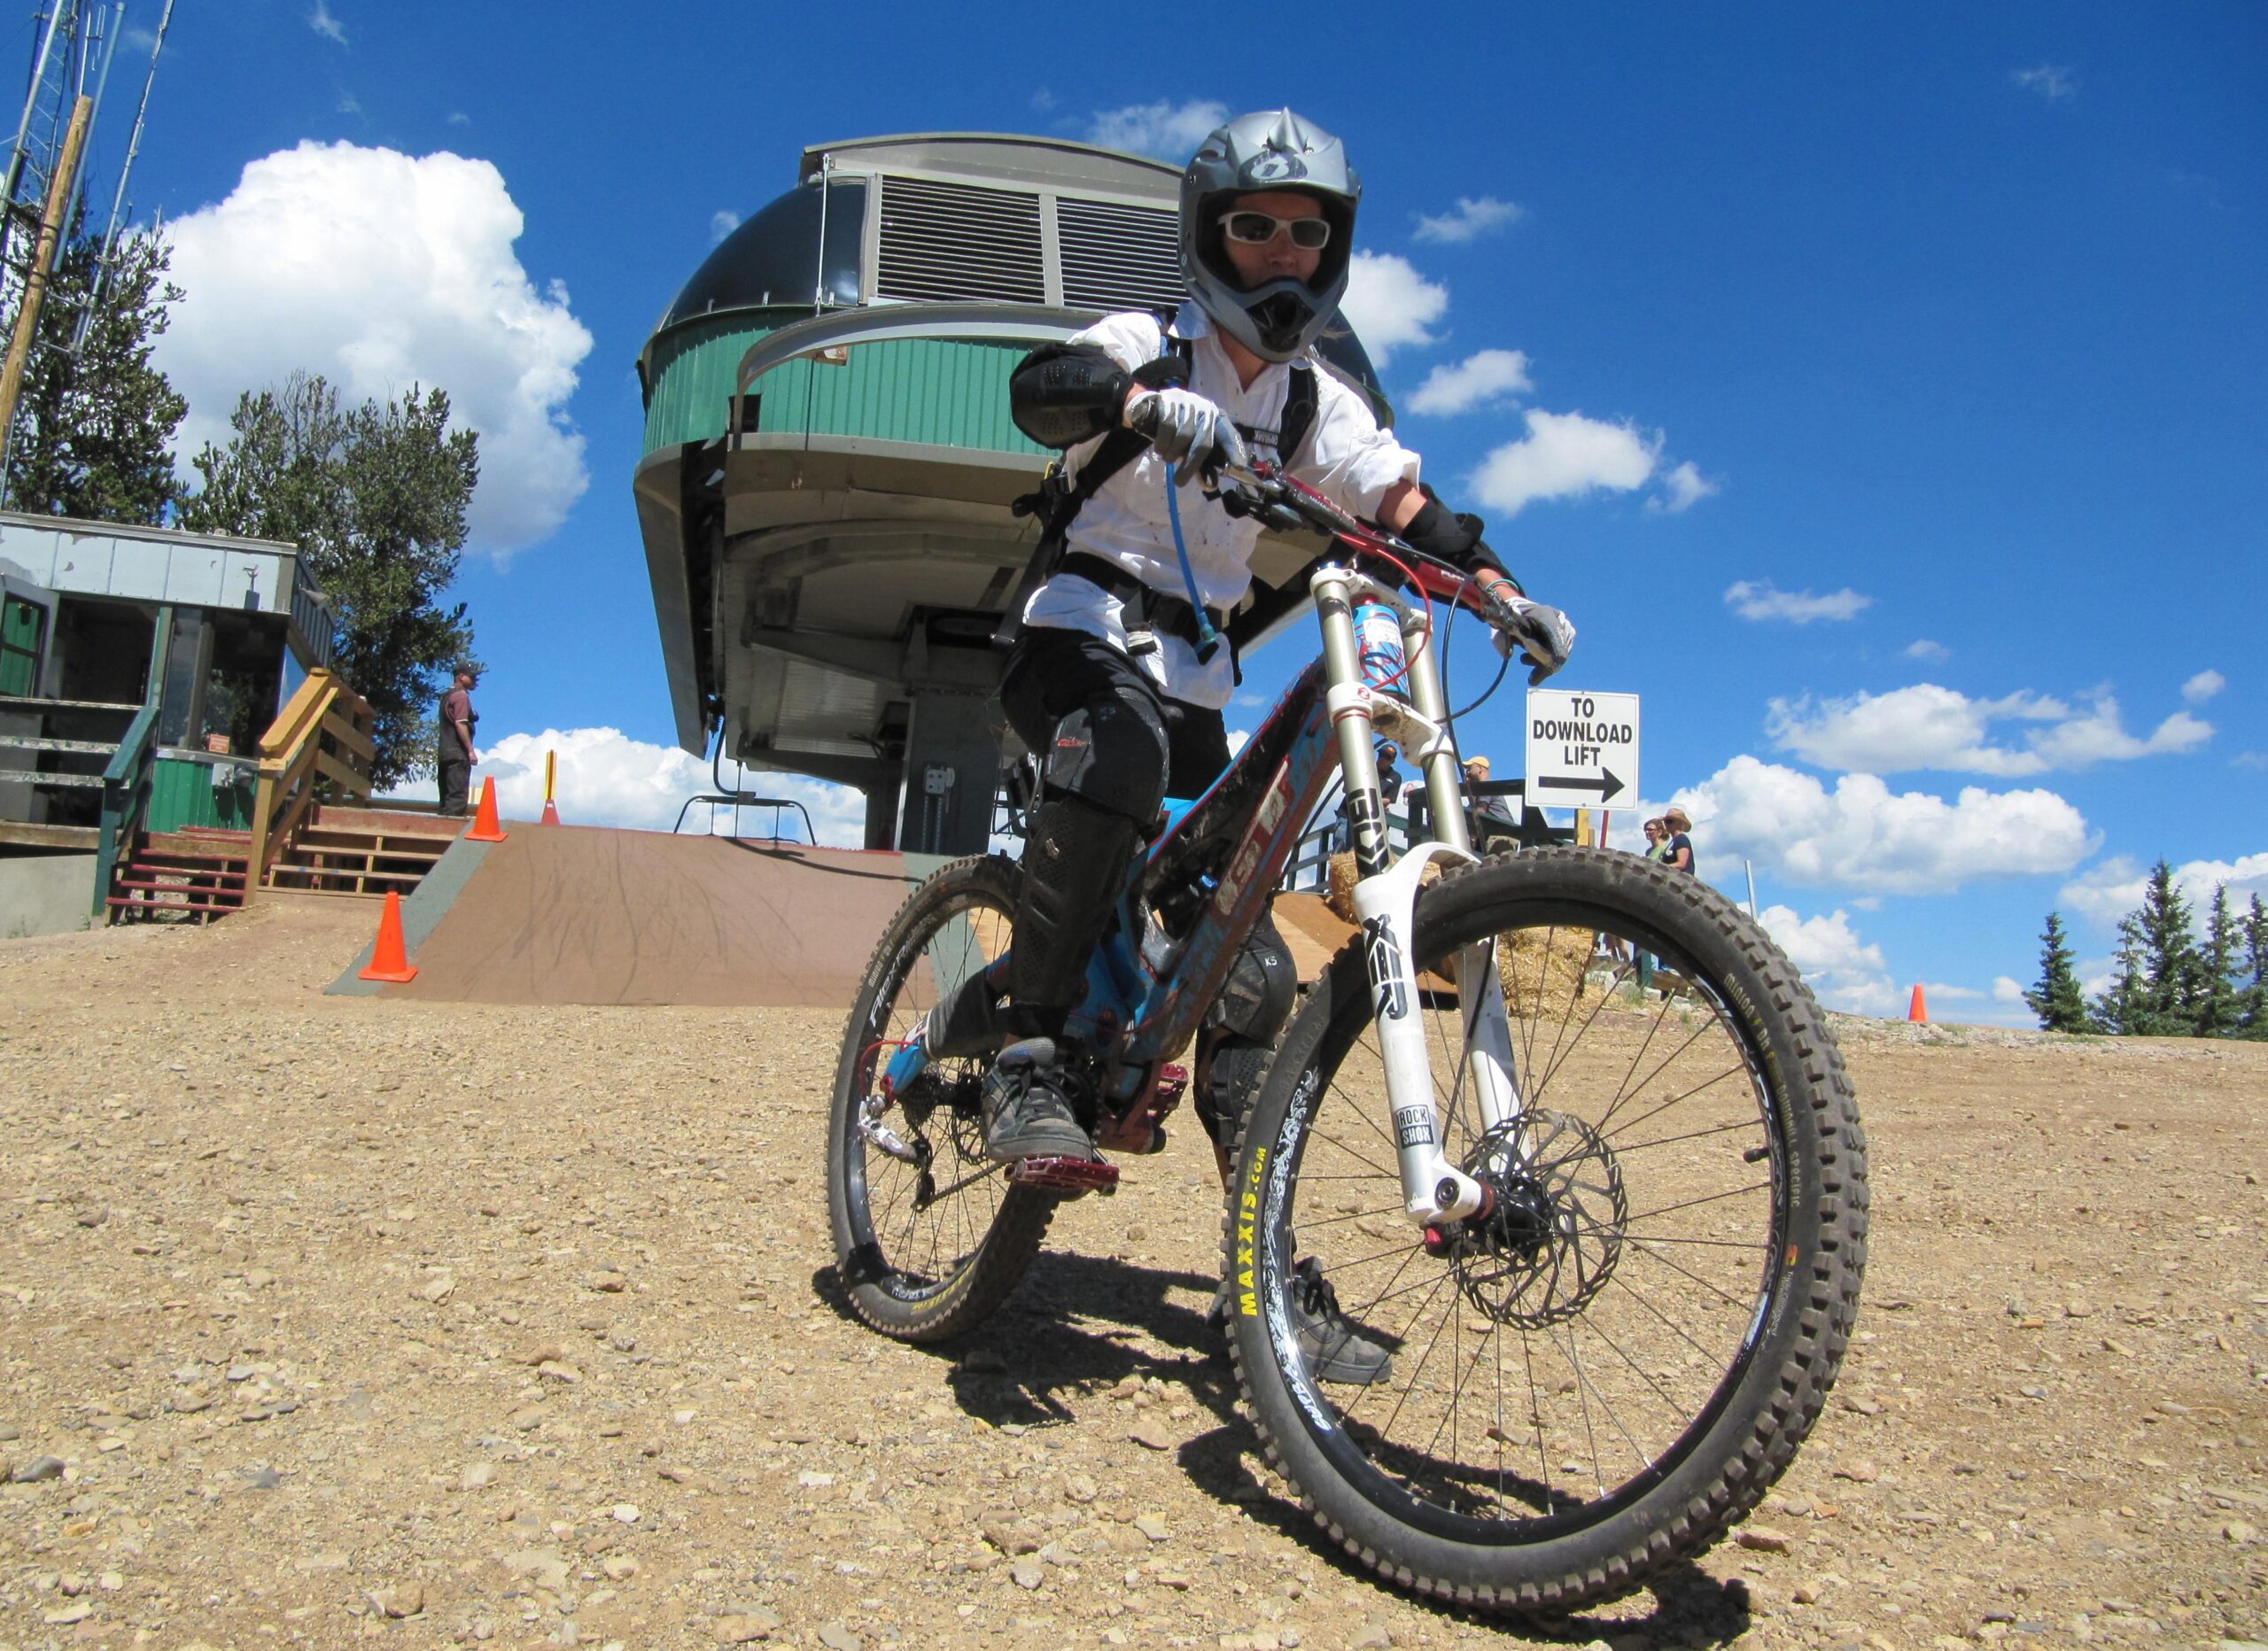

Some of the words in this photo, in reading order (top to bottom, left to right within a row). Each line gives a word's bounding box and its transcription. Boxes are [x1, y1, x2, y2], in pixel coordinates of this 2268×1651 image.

[1571, 697, 1595, 718] TO
[1533, 719, 1633, 744] DOWNLOAD
[1564, 745, 1601, 766] LIFT
[1399, 1108, 1428, 1128] ROCK
[1402, 1126, 1432, 1145] SHOX
